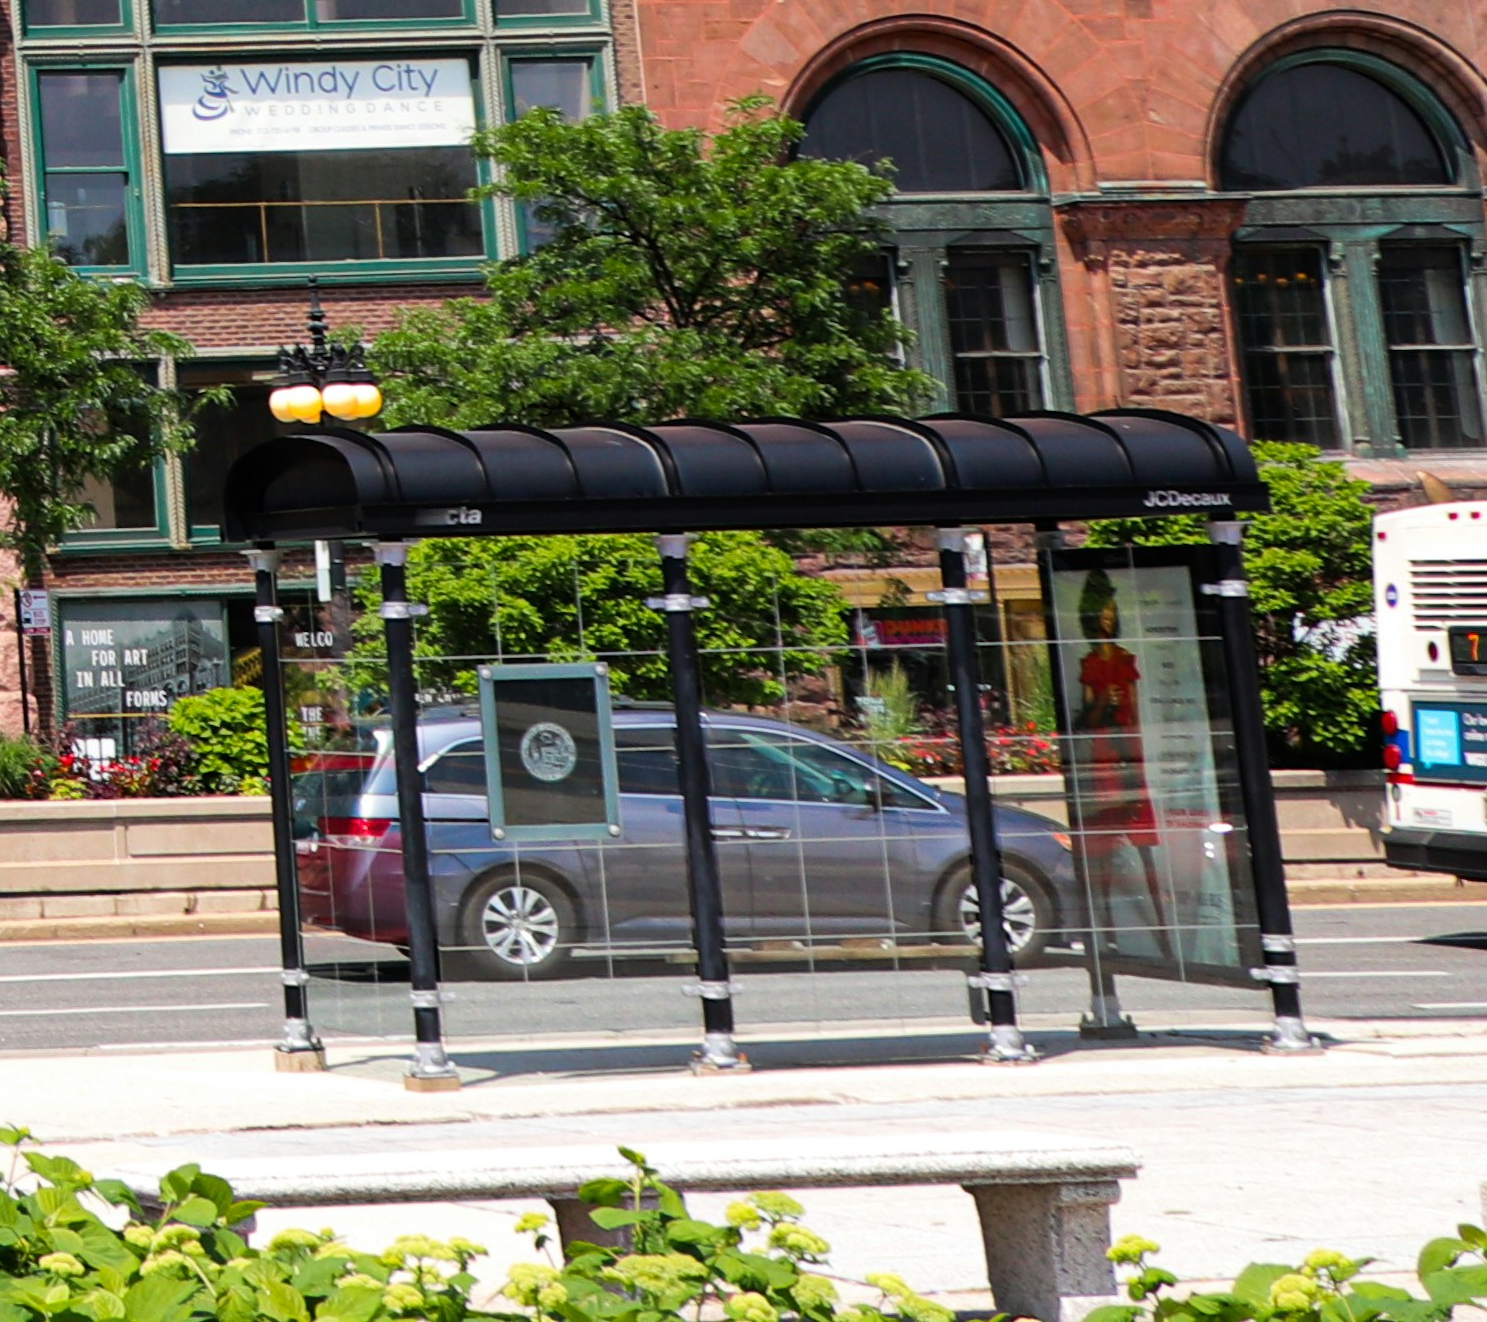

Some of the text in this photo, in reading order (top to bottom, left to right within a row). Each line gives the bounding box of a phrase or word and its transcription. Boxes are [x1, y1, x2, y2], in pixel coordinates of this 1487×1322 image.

[240, 64, 438, 99] Windy City
[245, 101, 444, 117] WEDDING DANCE
[1143, 490, 1232, 507] JCDecaux
[446, 507, 483, 524] cta
[66, 630, 74, 646] A
[82, 629, 114, 646] HOME
[92, 649, 149, 666] FOR ART
[76, 671, 126, 687] IN ALL
[126, 691, 167, 707] FORMS
